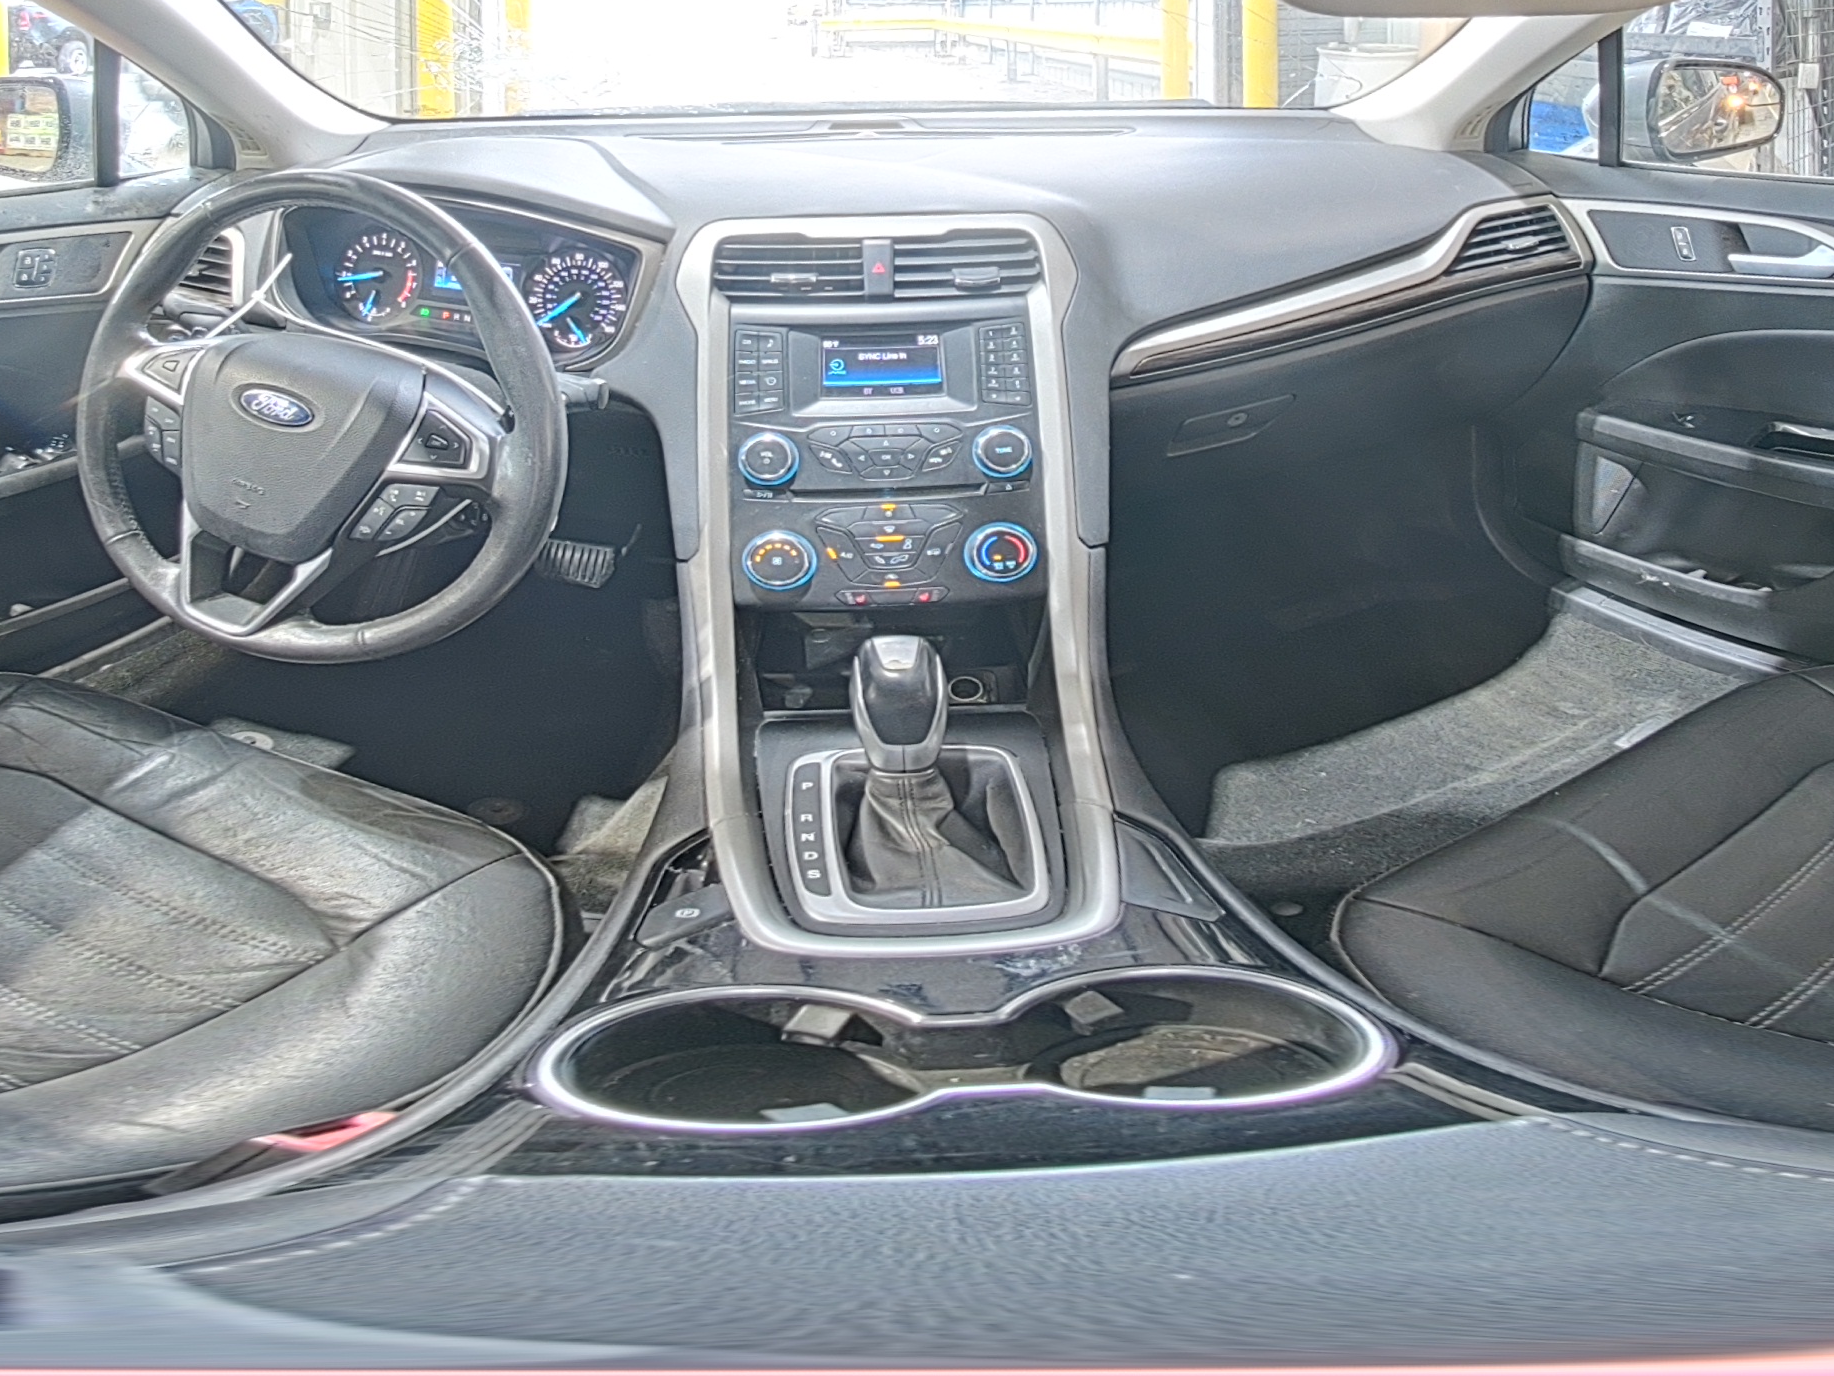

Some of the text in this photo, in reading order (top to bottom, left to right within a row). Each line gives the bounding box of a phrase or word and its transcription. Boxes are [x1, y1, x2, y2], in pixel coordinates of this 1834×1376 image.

[251, 393, 298, 420] Ford
[802, 781, 814, 791] P
[800, 813, 814, 823] R
[801, 831, 816, 842] N
[803, 851, 819, 861] D
[806, 869, 822, 880] S
